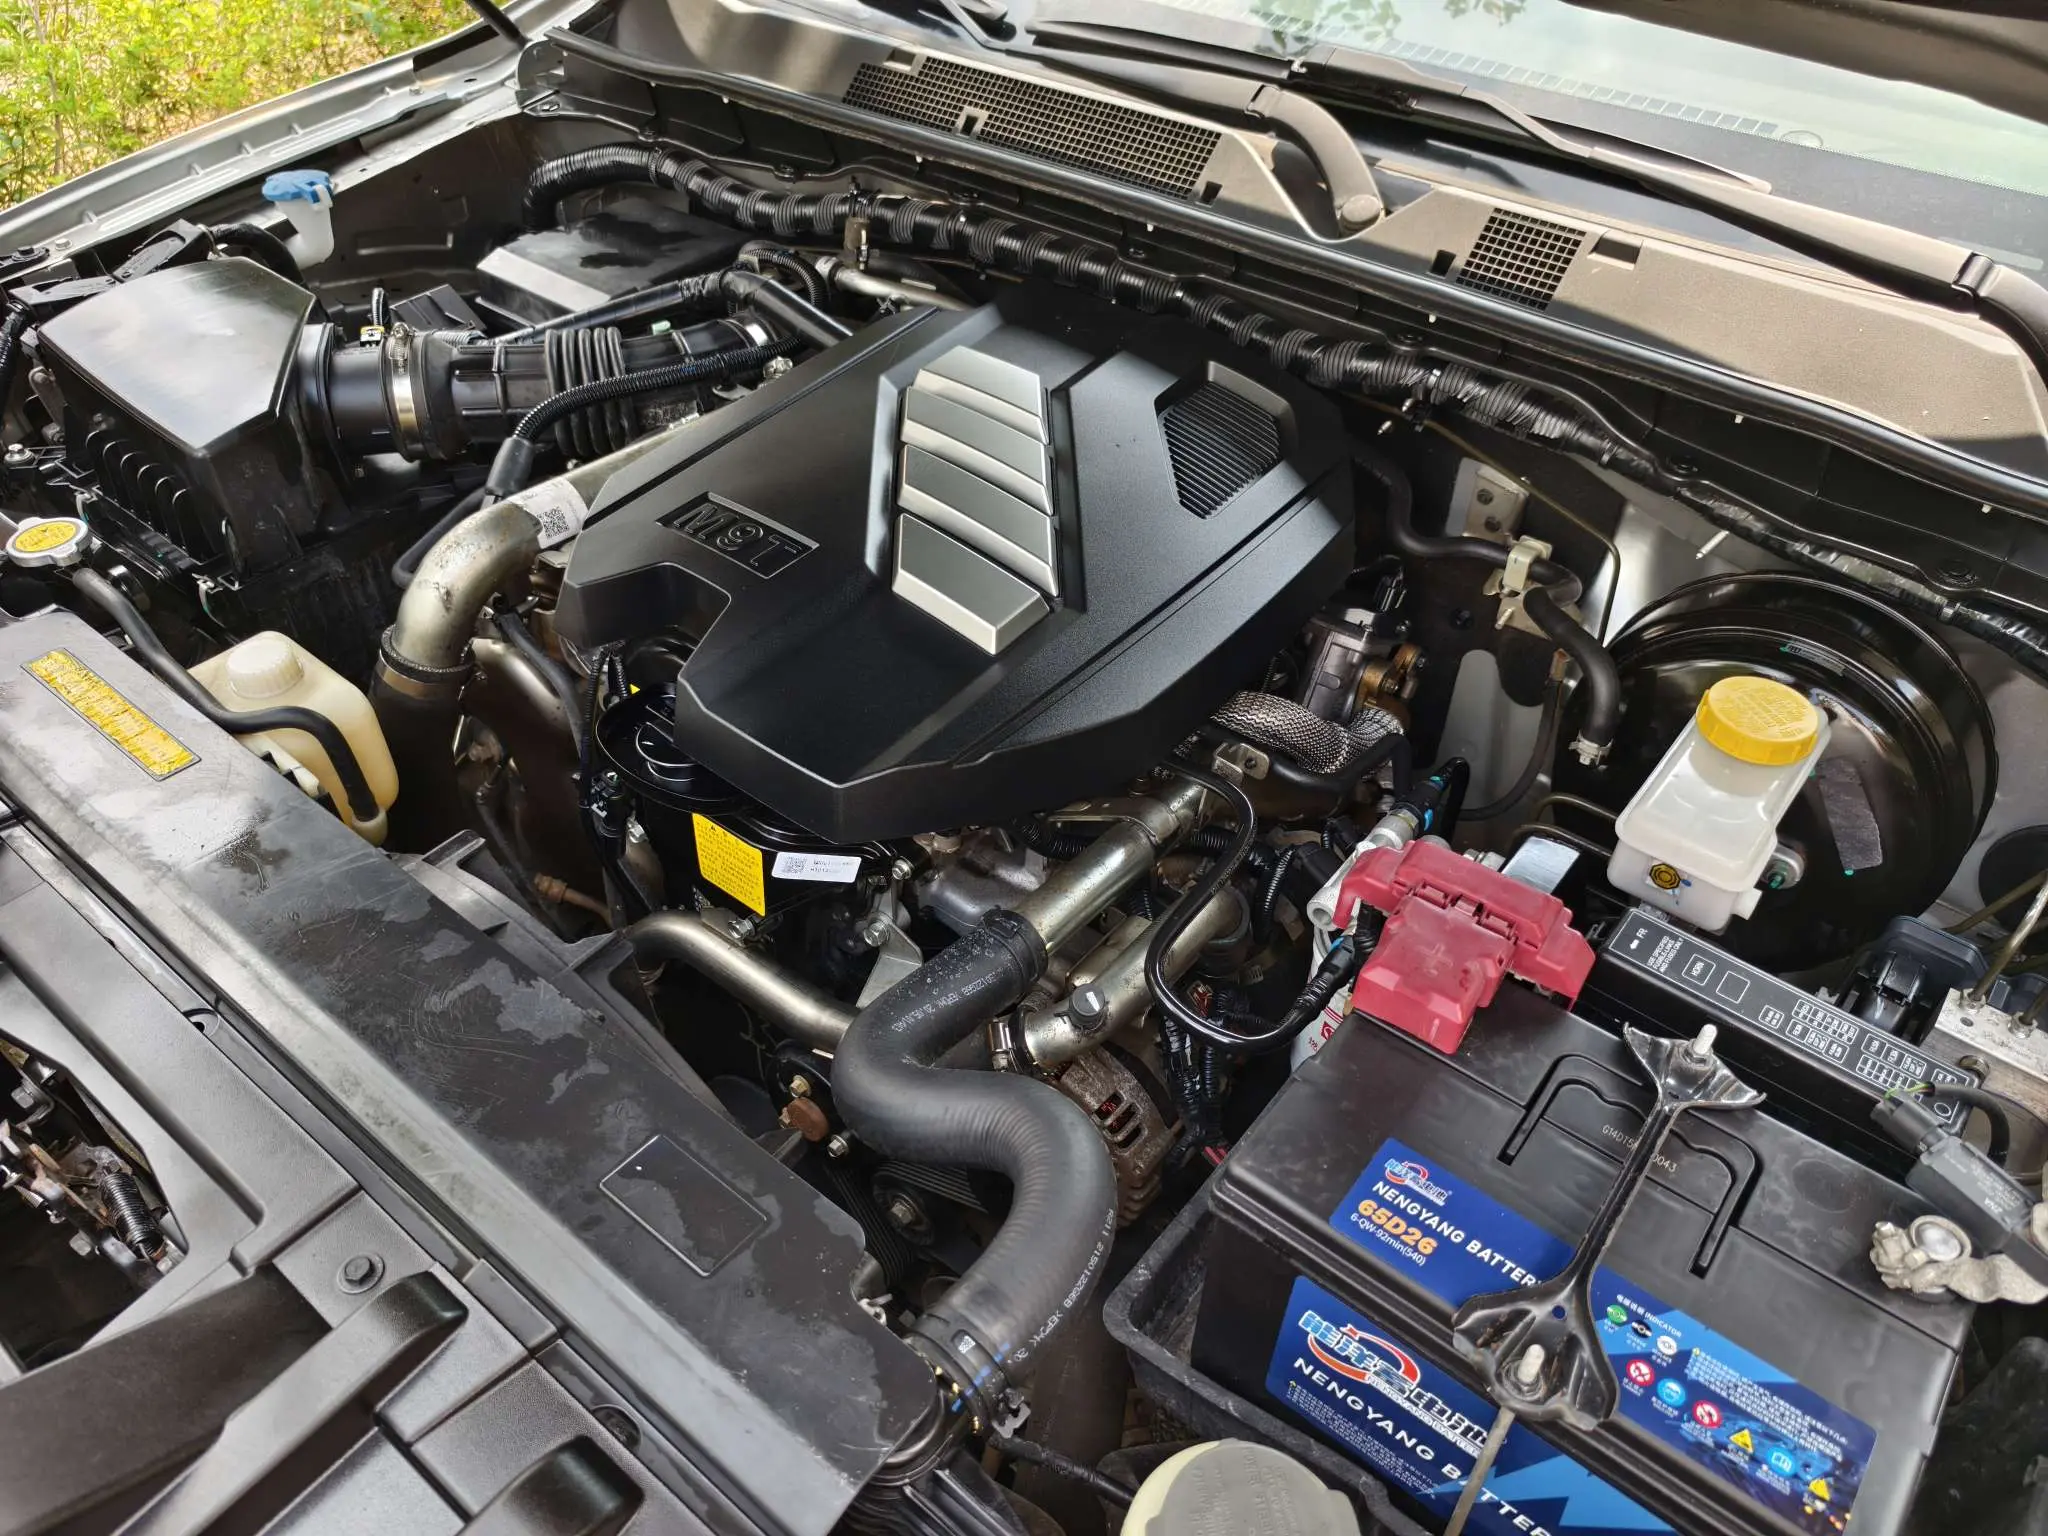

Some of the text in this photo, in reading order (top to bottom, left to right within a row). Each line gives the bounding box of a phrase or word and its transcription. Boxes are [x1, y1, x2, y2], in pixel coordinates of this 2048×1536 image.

[673, 502, 802, 566] M9T
[1689, 959, 1705, 977] HORN
[1350, 1213, 1427, 1266] 6-QW-92min(540)
[1358, 1199, 1438, 1255] 65D26
[1372, 1181, 1465, 1243] NENGYANG
[1465, 1239, 1542, 1288] BATTER
[1645, 1310, 1682, 1338] INDICATOR
[1293, 1357, 1435, 1461] NENGYANG
